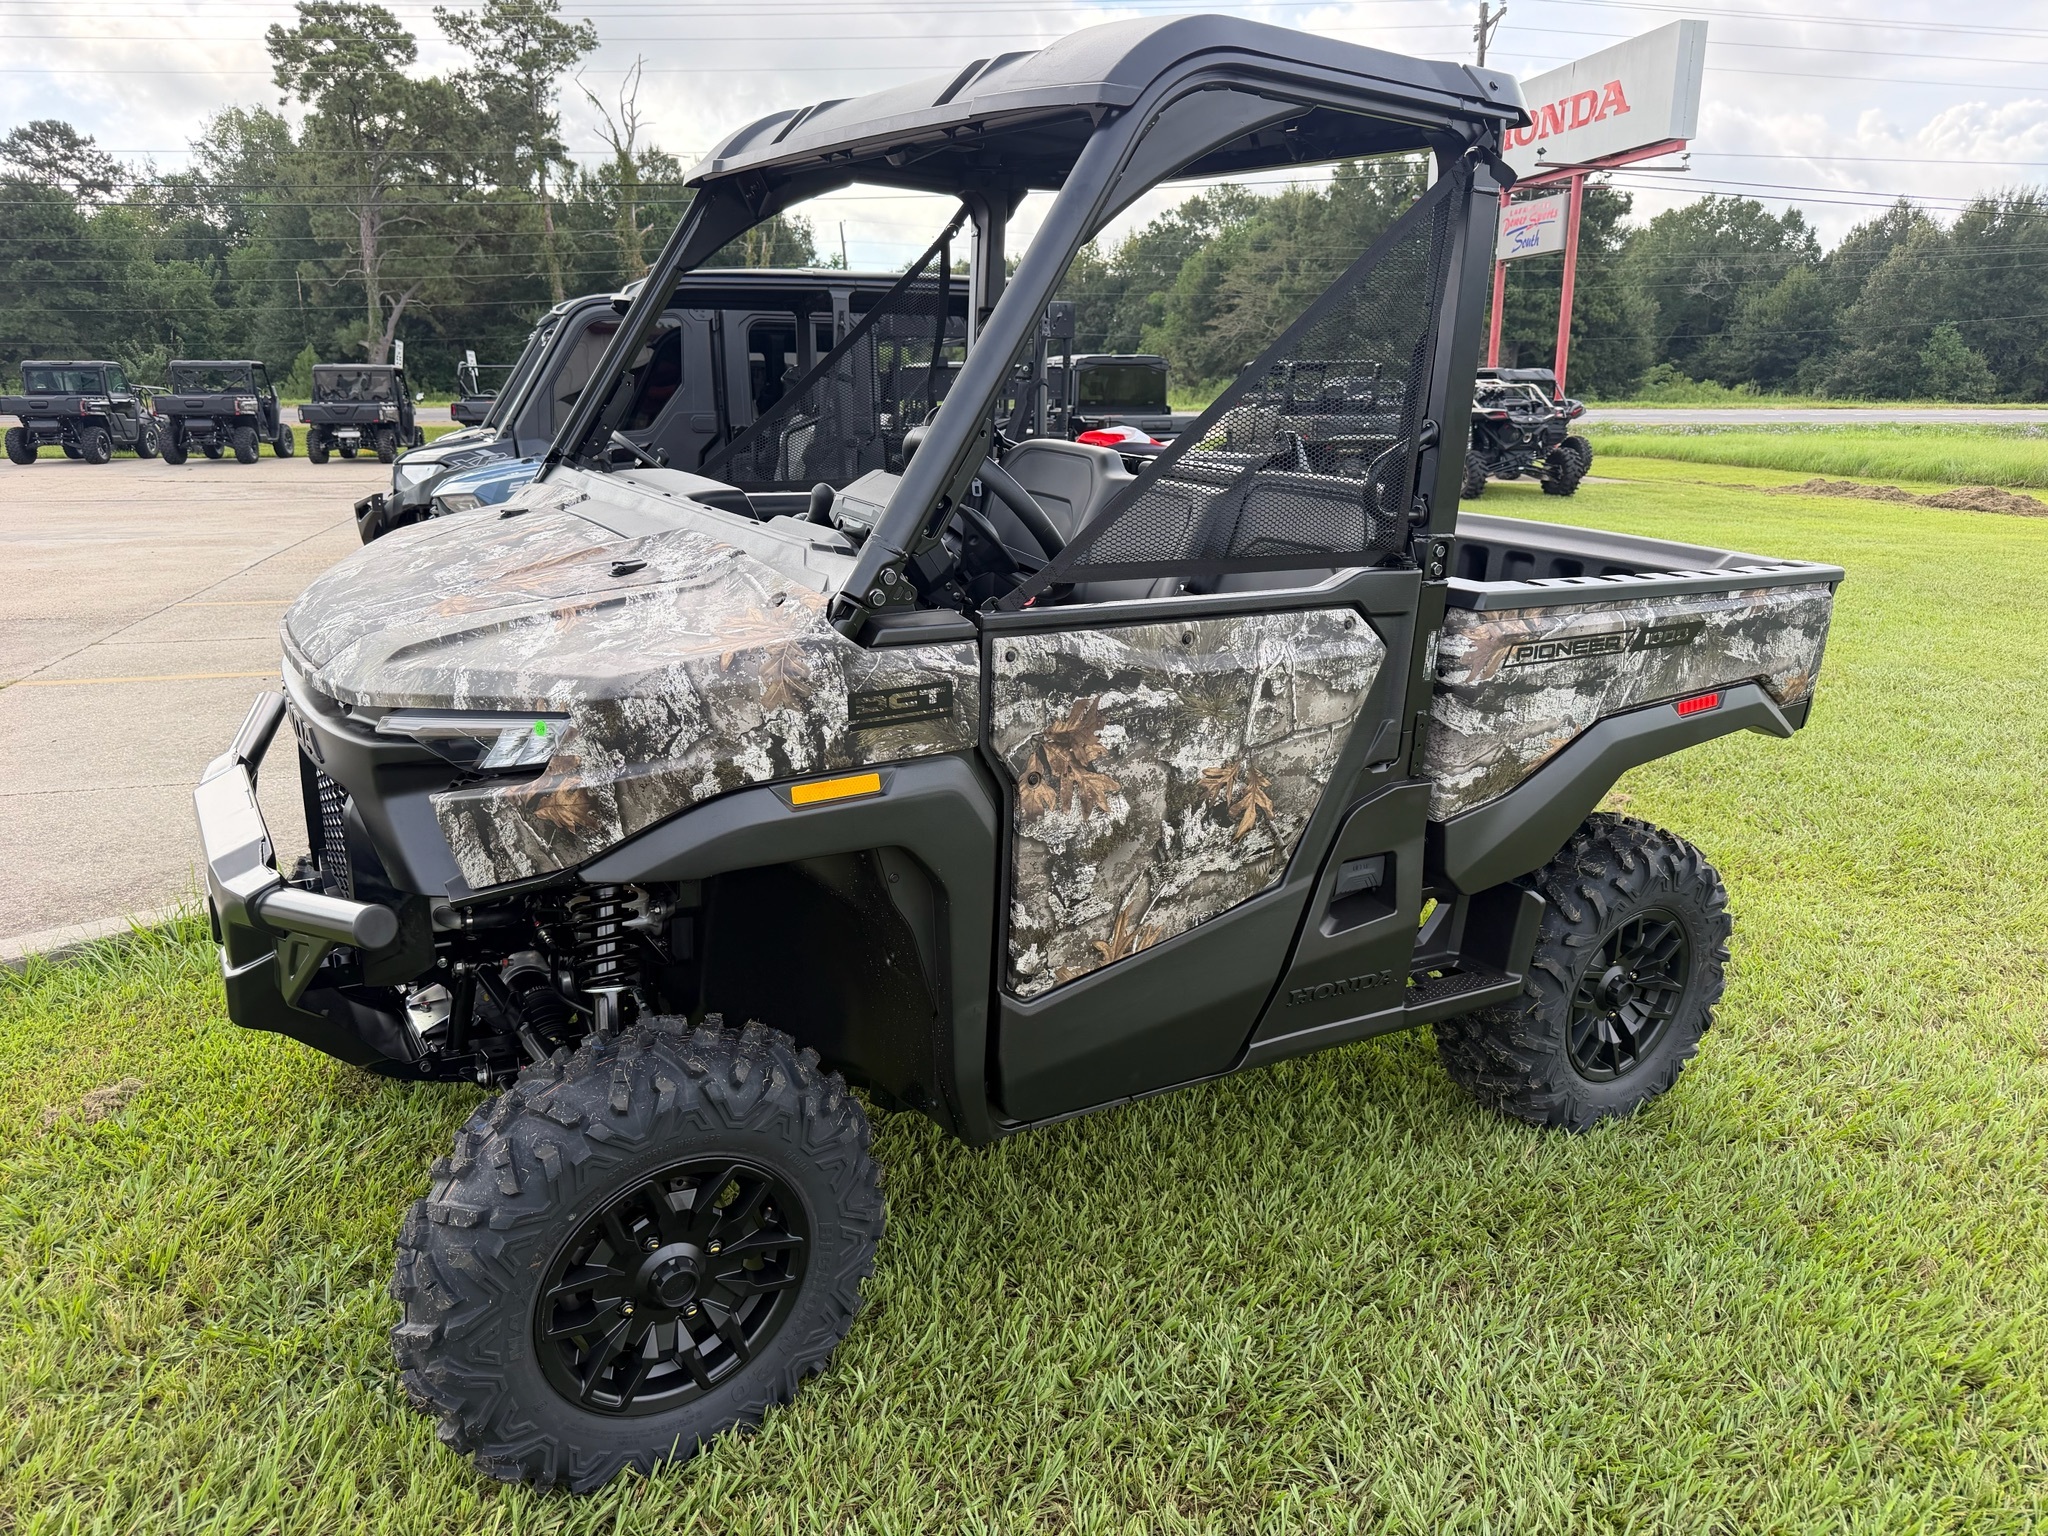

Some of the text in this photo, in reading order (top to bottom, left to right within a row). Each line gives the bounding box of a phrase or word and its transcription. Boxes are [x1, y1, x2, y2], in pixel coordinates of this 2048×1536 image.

[1503, 80, 1631, 151] ONDA
[1511, 229, 1539, 253] South
[1516, 627, 1690, 662] PIONEER 1000
[1286, 969, 1398, 1007] HONDA
